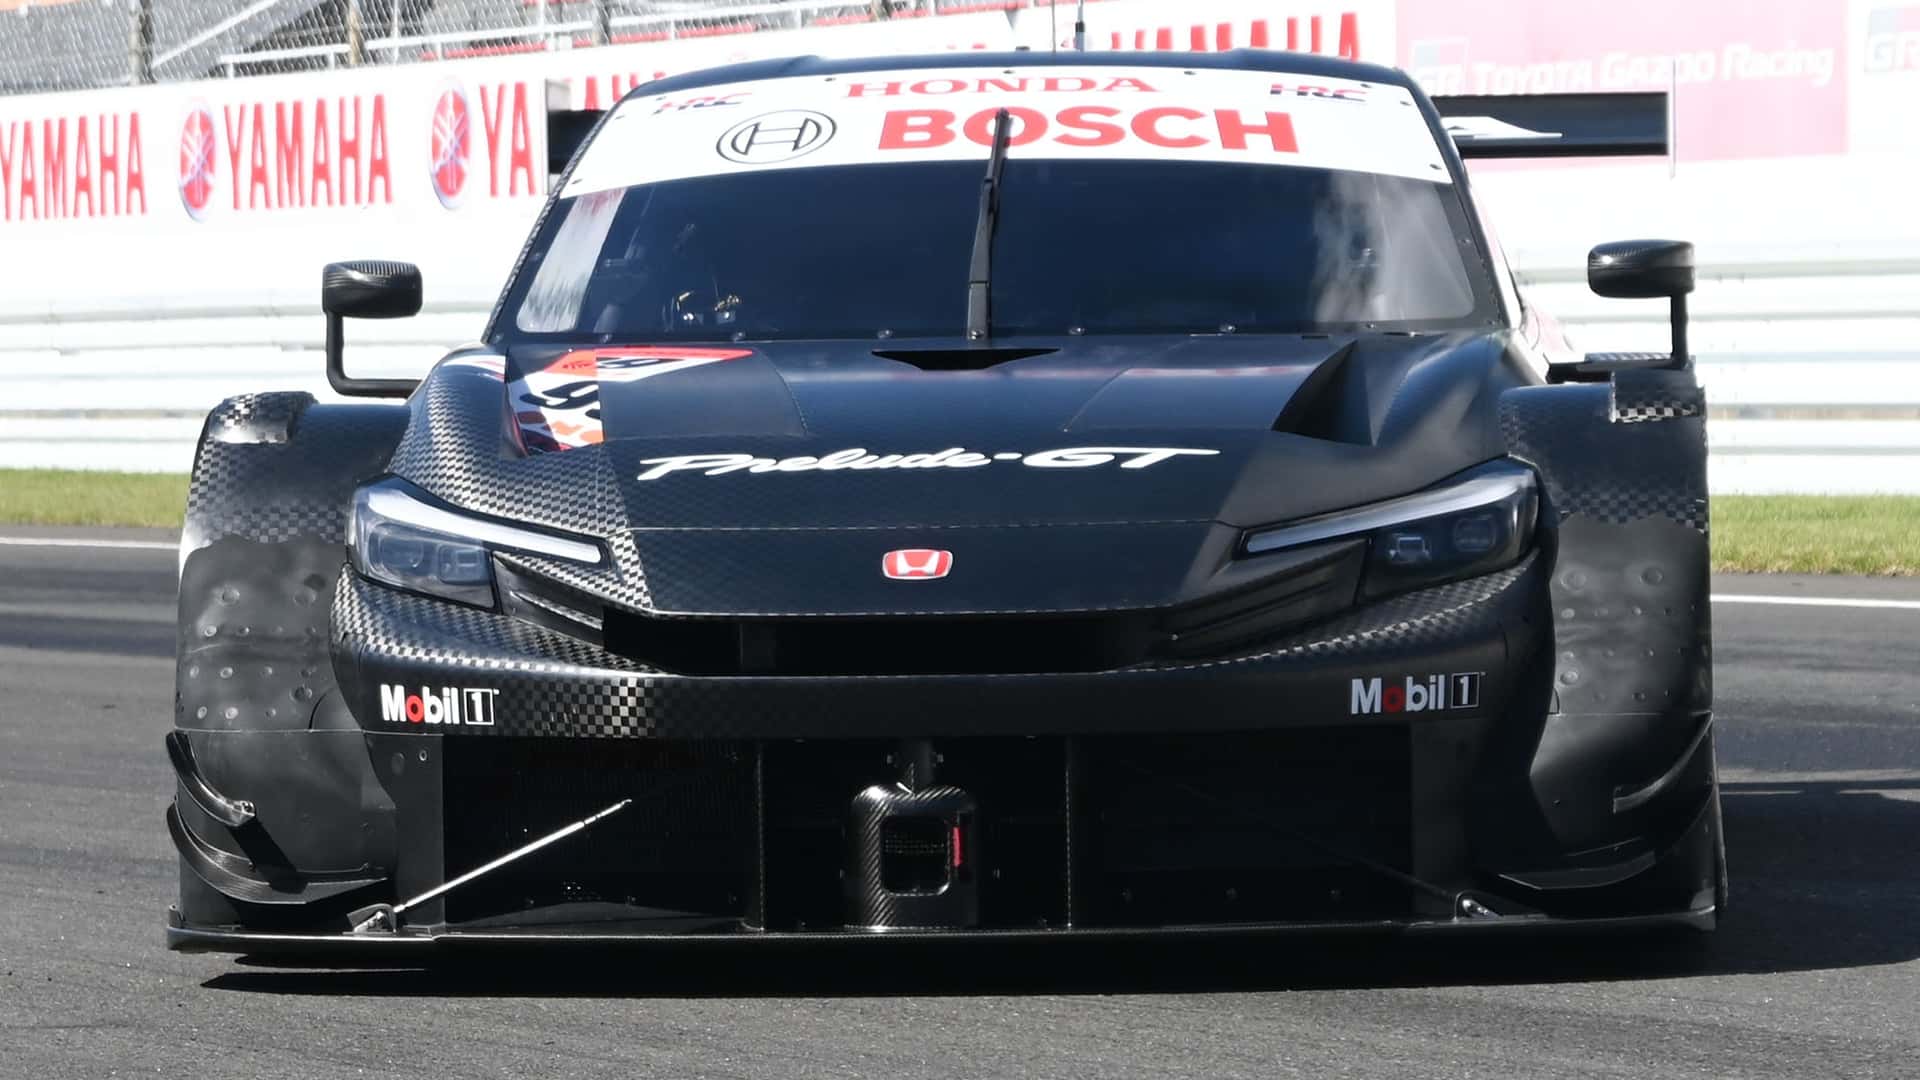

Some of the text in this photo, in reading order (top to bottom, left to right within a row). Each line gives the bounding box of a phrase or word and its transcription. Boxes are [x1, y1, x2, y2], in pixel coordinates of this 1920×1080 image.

[1722, 42, 1834, 87] Racing
[846, 77, 1156, 98] HONDA
[223, 94, 393, 211] YAMAHA
[878, 106, 1299, 154] BOSCH
[0, 111, 148, 222] YAMAHA
[380, 684, 460, 725] Mobil
[1351, 675, 1445, 714] Mobil
